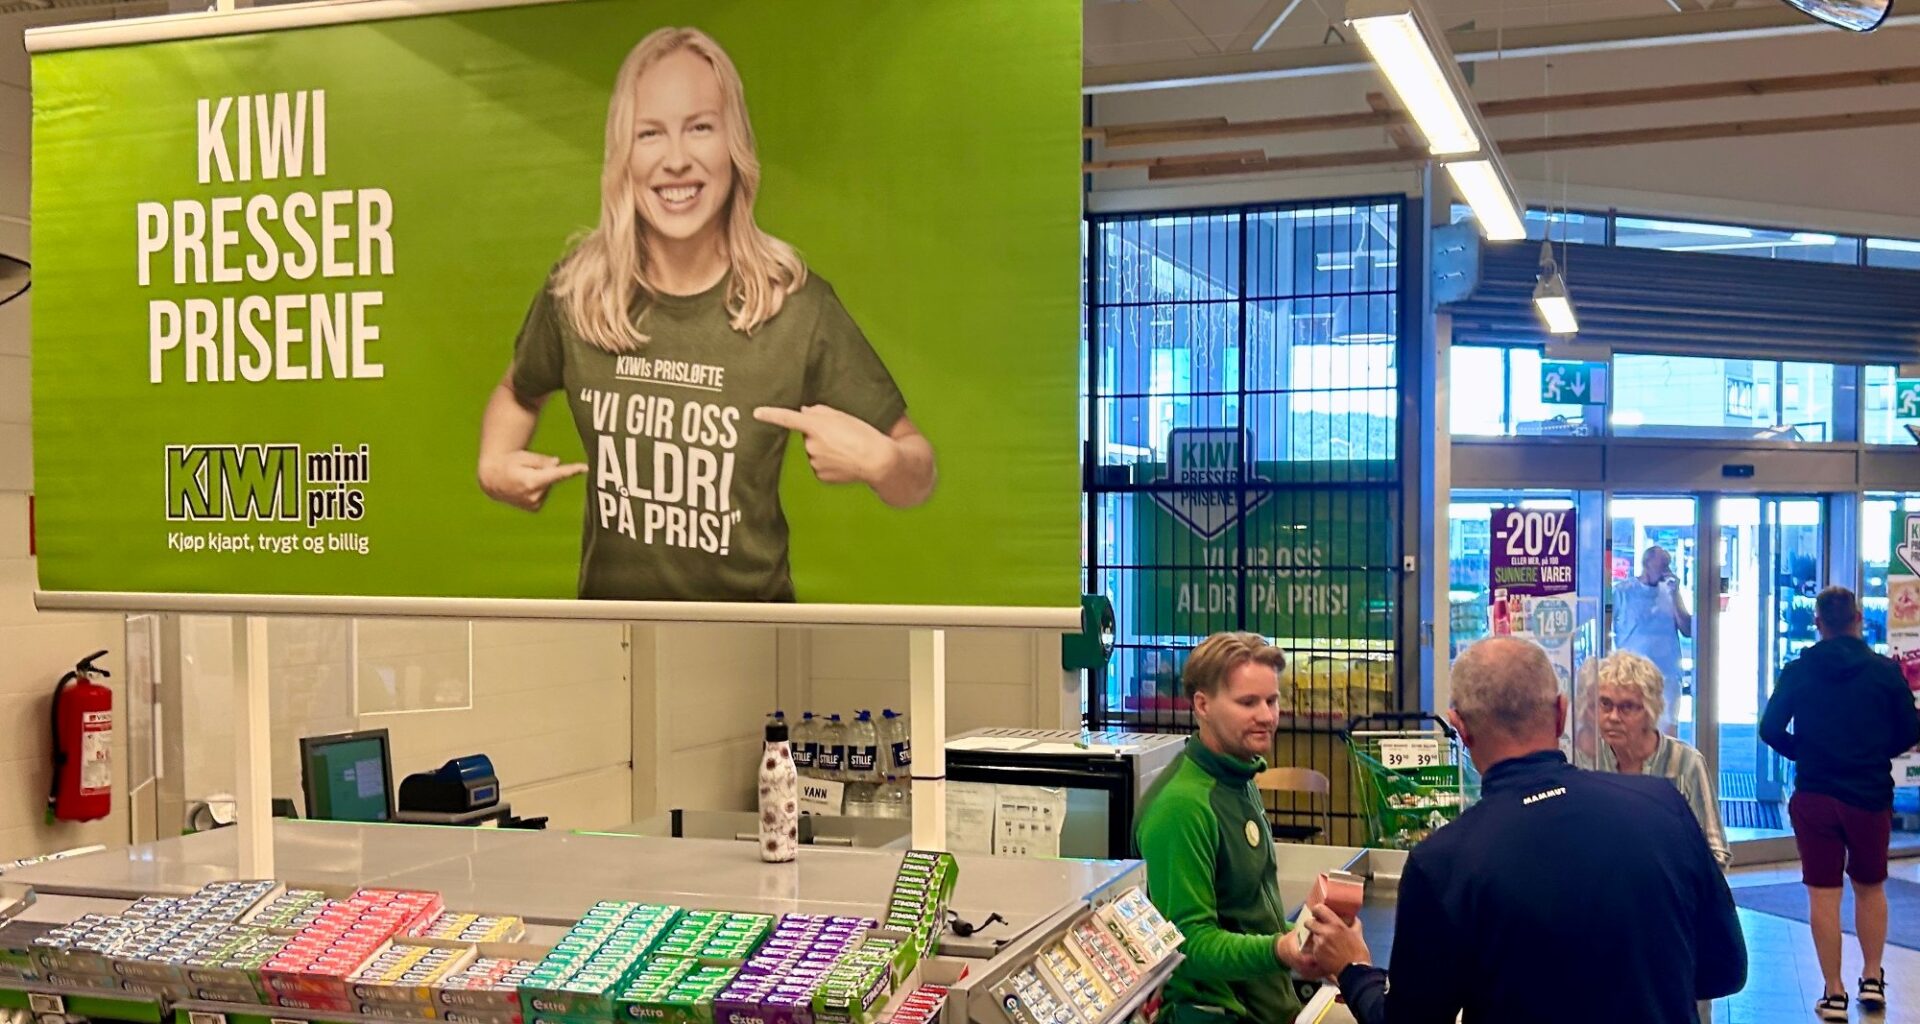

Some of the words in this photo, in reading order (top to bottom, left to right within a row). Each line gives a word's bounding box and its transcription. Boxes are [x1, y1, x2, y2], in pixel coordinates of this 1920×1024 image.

[197, 89, 326, 184] KIWI
[137, 188, 394, 286] PRESSER
[149, 291, 384, 383] PRISENE
[615, 355, 651, 378] KIWIs
[653, 359, 725, 387] PRISLØFTE
[626, 394, 675, 440] GIR
[681, 401, 740, 449] OSS
[165, 444, 301, 521] KIWI
[307, 444, 369, 483] mini
[597, 435, 735, 513] ALDRI
[306, 483, 364, 528] pris
[597, 486, 637, 540] PÅ
[168, 532, 205, 552] Kjøp
[208, 532, 254, 552] kjapt,
[259, 534, 299, 553] trygt
[303, 538, 325, 554] og
[328, 532, 369, 554] billig
[1497, 512, 1570, 556] -20%
[1276, 547, 1321, 578] OSS
[1495, 567, 1537, 583] SUNNERE
[1541, 566, 1572, 582] VARER
[1287, 584, 1349, 615] PRIS!
[792, 752, 812, 762] STILLE
[820, 754, 839, 765] STILLE
[851, 755, 873, 765] STILLE
[803, 786, 828, 799] VANN
[1523, 787, 1567, 805] MAMMUT
[533, 999, 566, 1012] extra
[629, 1006, 664, 1018] extra
